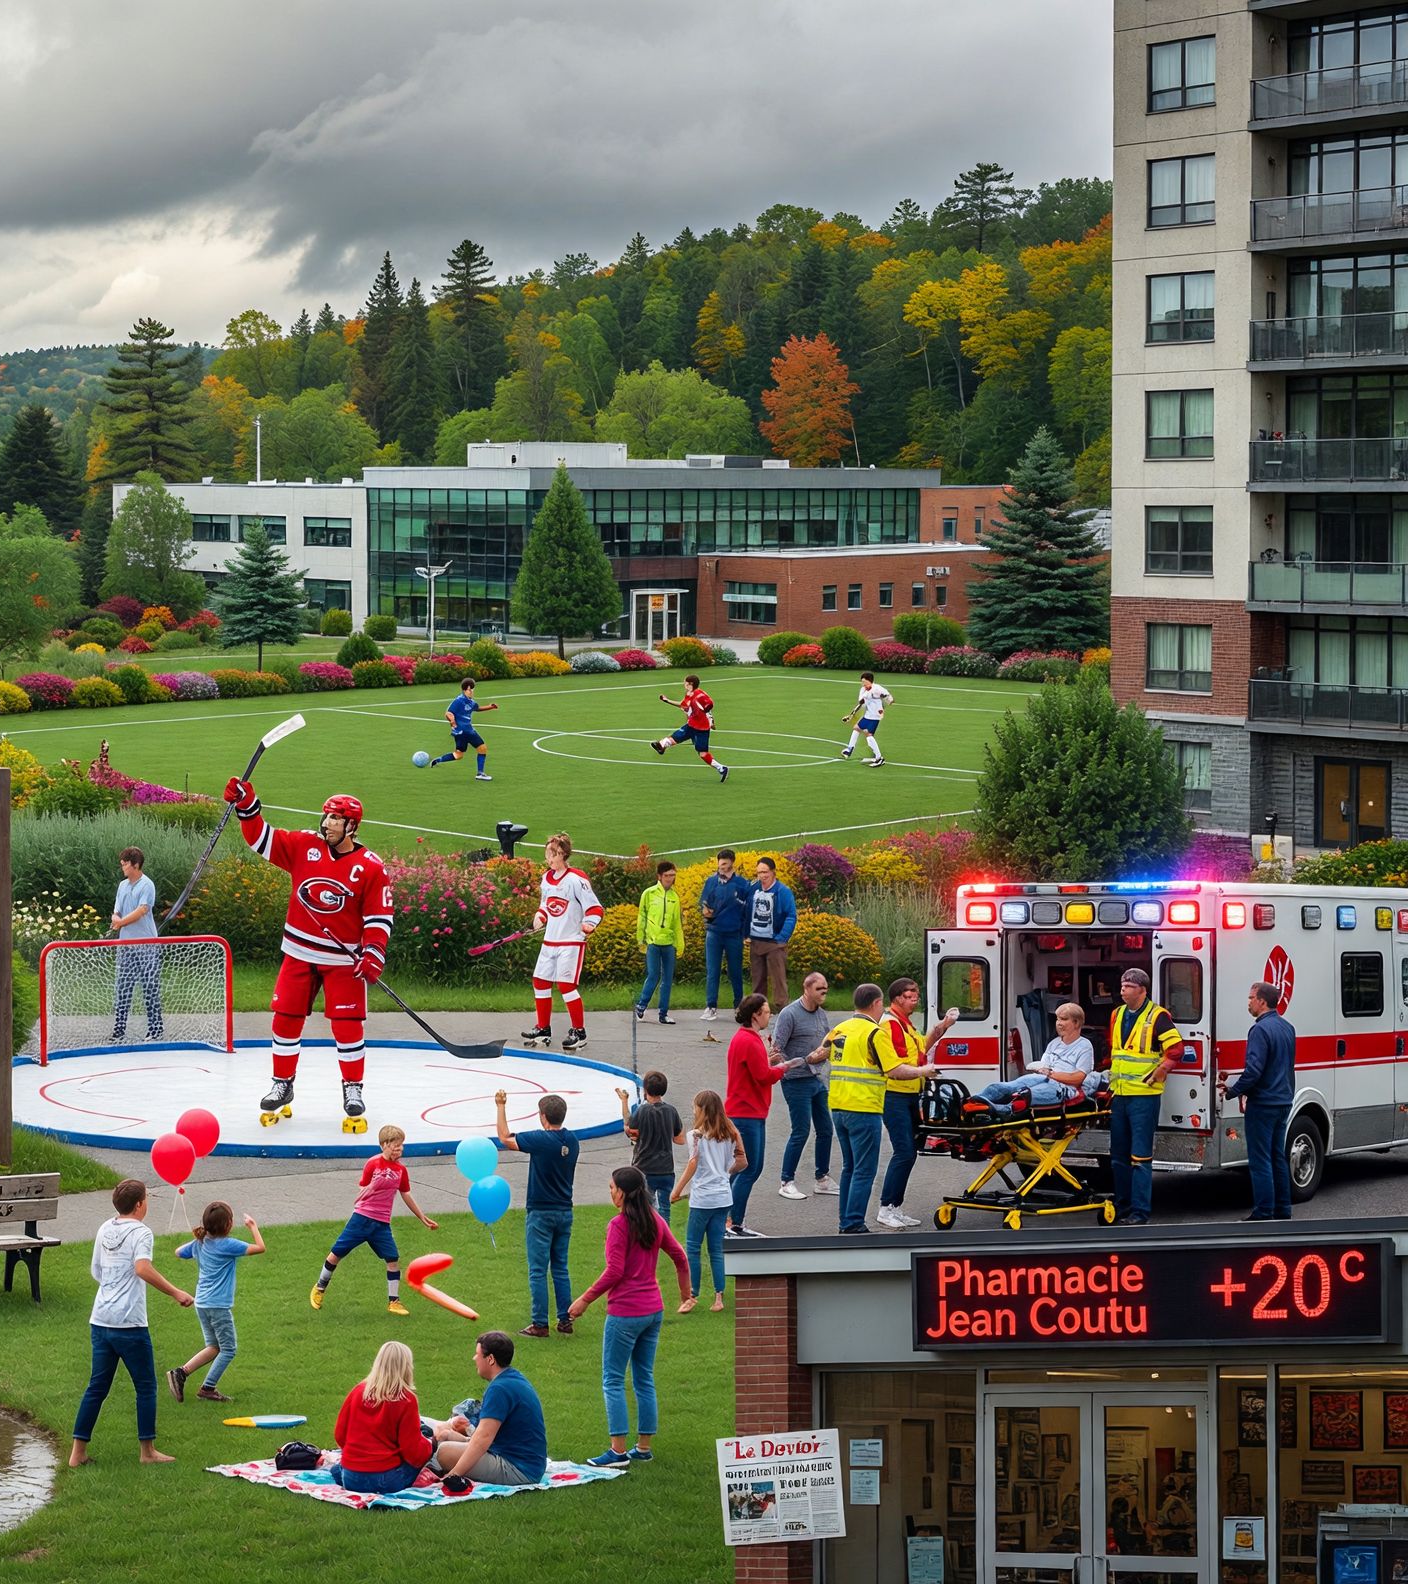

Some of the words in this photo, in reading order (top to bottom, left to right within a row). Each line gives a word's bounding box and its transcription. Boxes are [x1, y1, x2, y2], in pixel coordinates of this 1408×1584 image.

[349, 864, 365, 883] C
[937, 1254, 1144, 1297] Pharmacie
[925, 1299, 1017, 1339] Jean
[1029, 1296, 1148, 1336] Coutu
